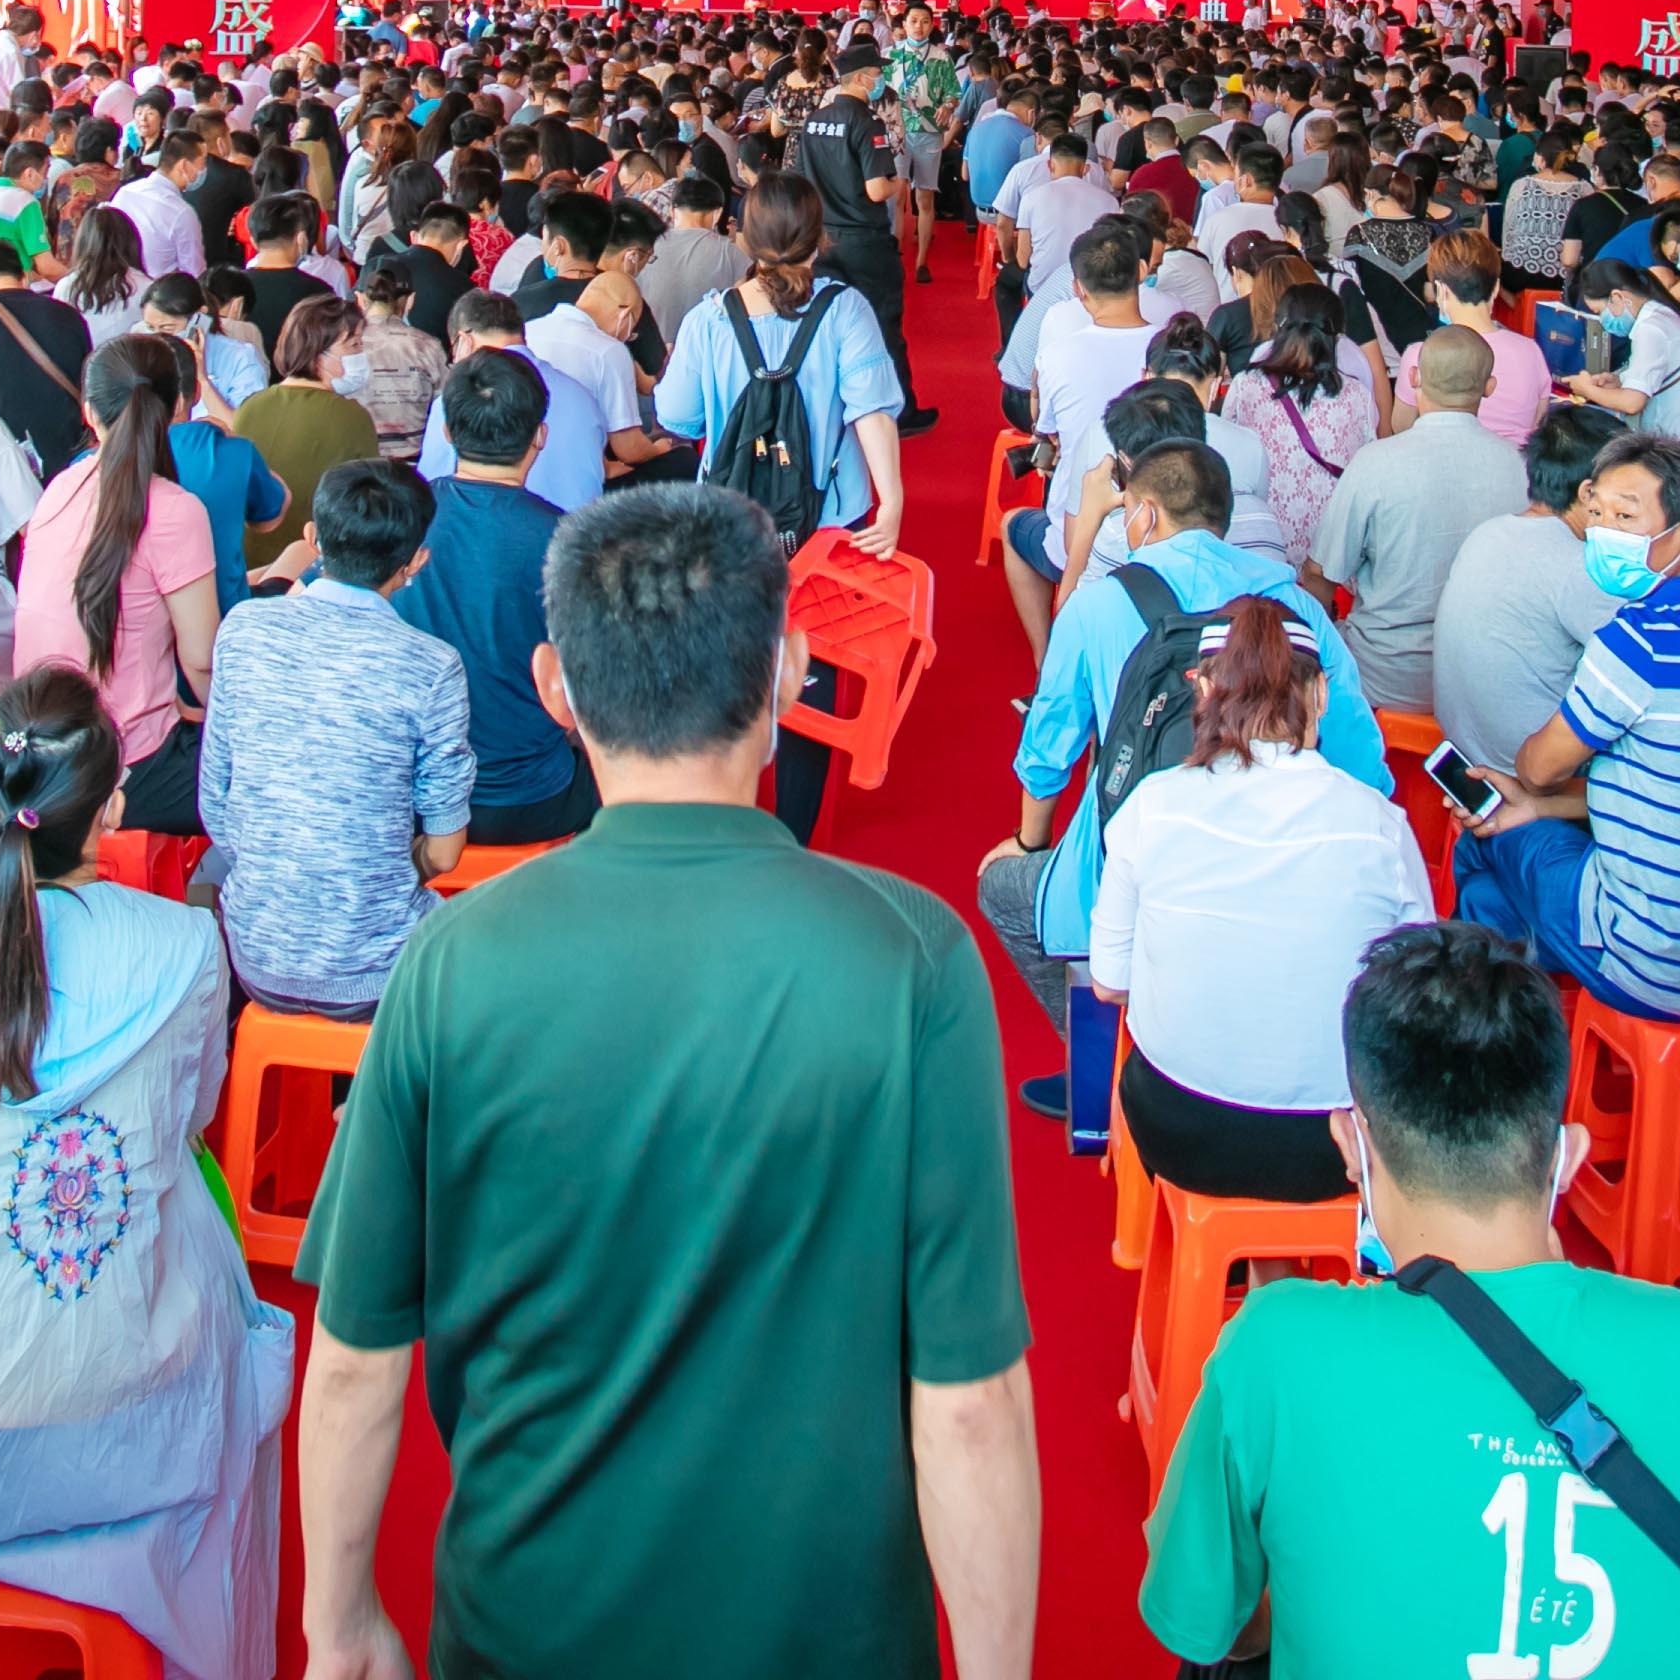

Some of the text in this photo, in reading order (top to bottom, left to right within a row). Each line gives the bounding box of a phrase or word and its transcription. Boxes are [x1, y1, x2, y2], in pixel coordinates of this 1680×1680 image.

[1467, 1433, 1562, 1457] THE AN
[1466, 1471, 1617, 1680] 15
